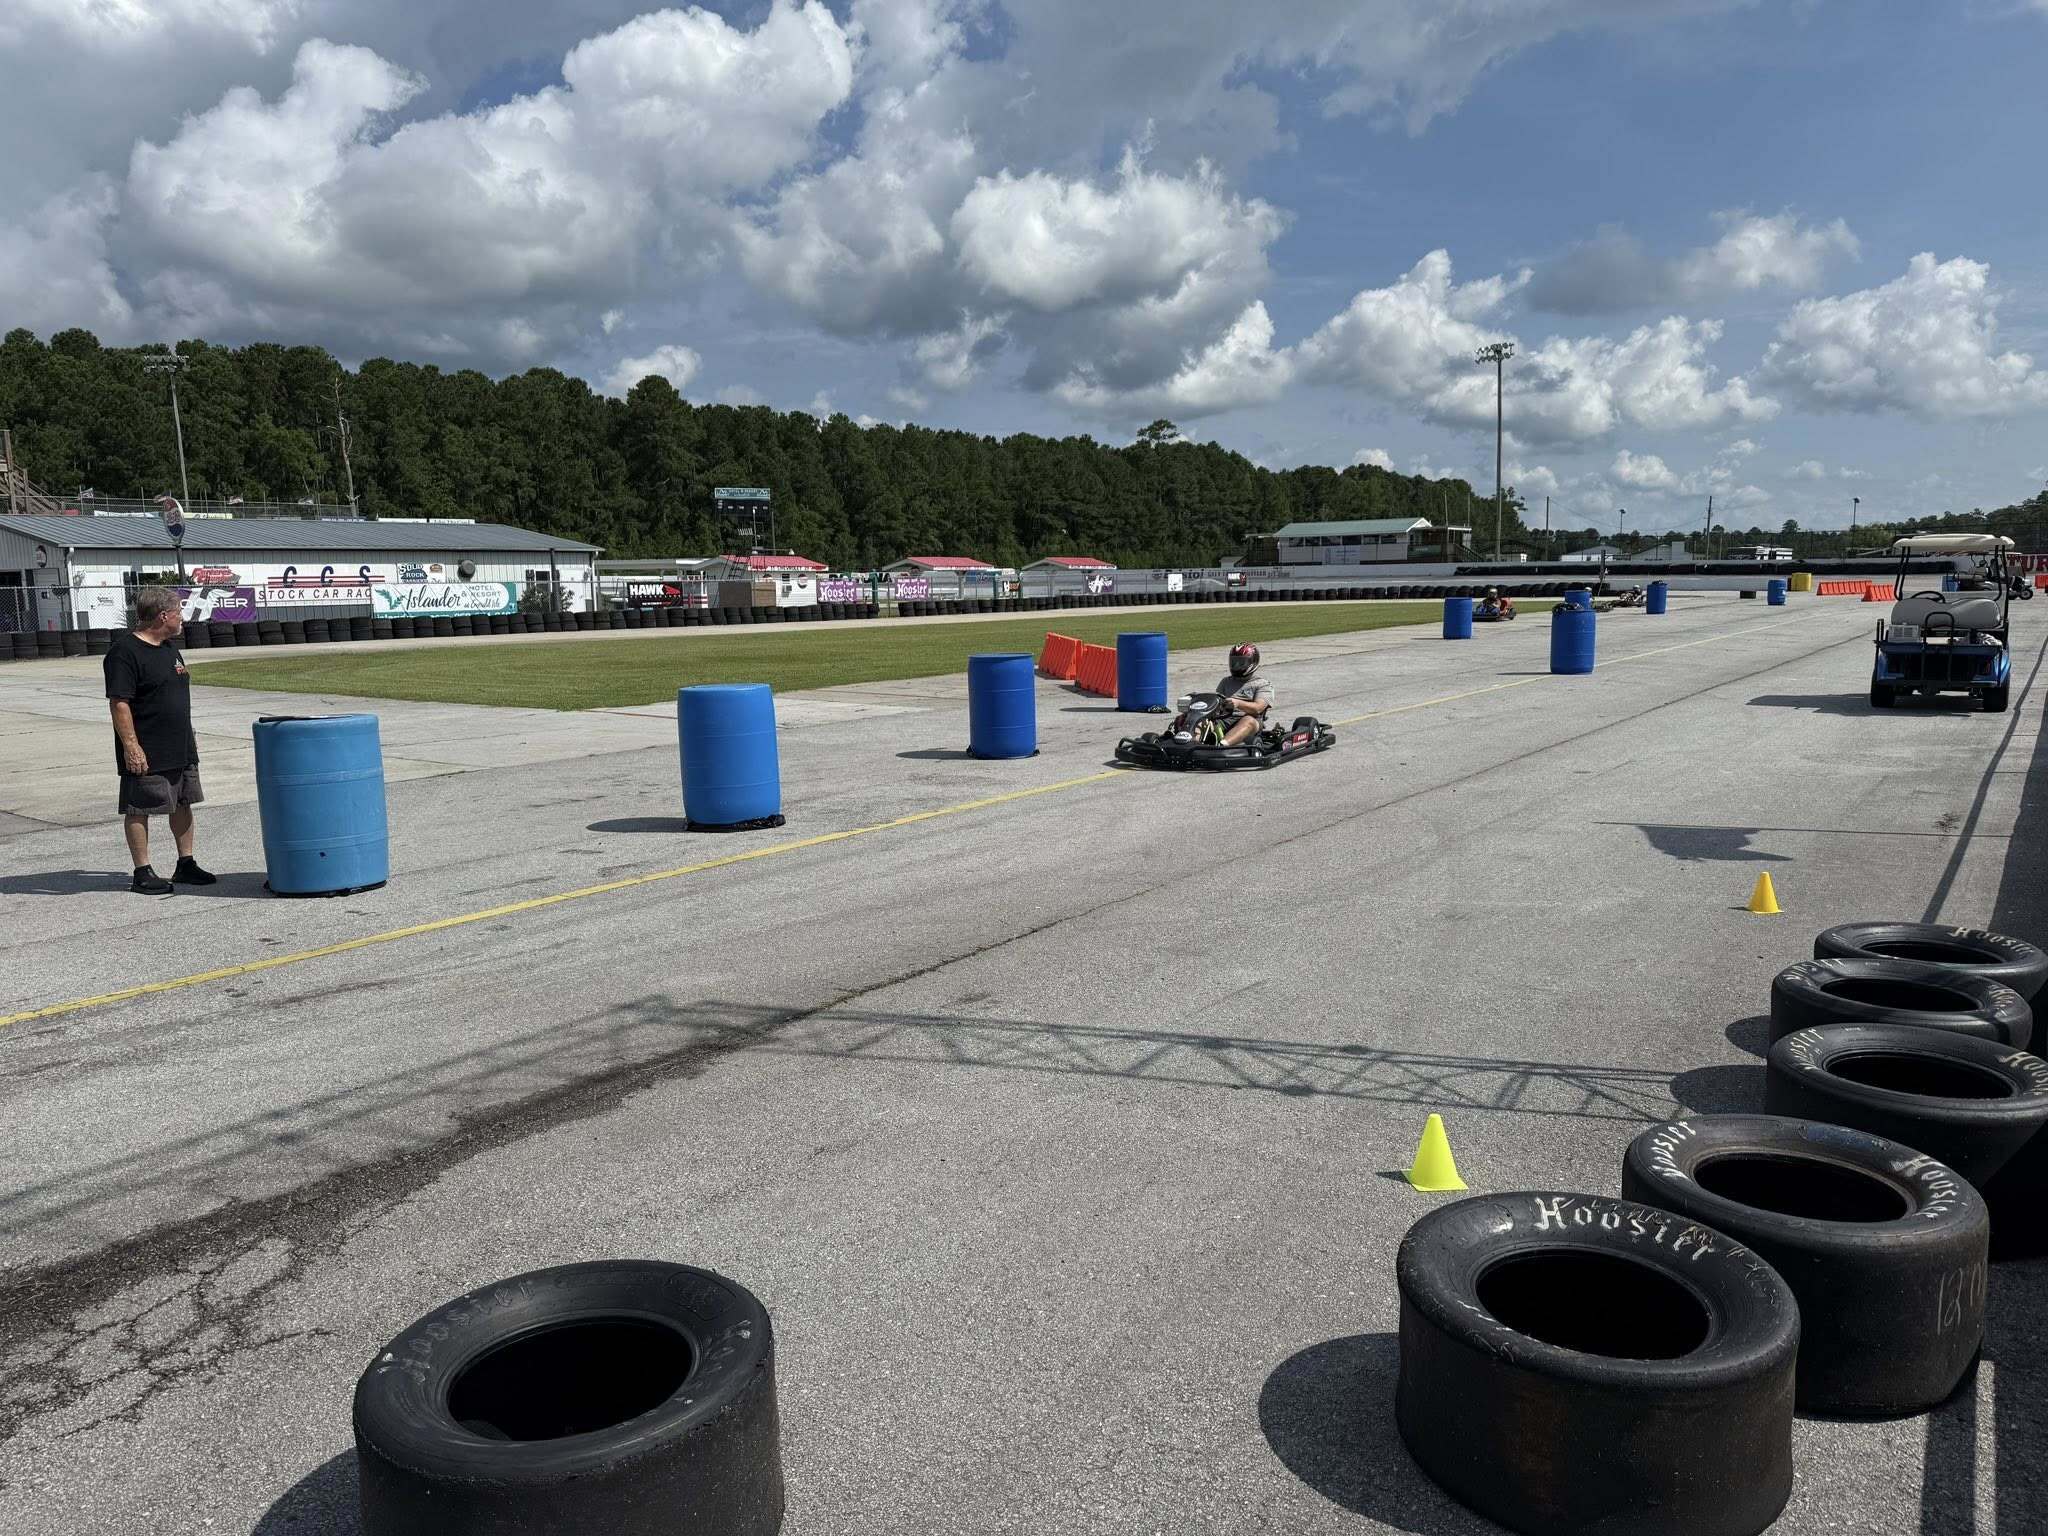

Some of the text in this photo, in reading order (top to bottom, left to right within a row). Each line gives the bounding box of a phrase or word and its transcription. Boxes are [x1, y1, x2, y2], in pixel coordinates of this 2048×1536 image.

[259, 589, 305, 599] STOCK
[313, 588, 338, 598] CAR
[406, 585, 460, 610] Islander
[629, 584, 664, 596] HAWK
[819, 584, 855, 601] Hoosier
[895, 582, 928, 598] Hoosier
[1890, 1153, 1968, 1218] Hoosier
[1533, 1197, 1715, 1261] Hoosier
